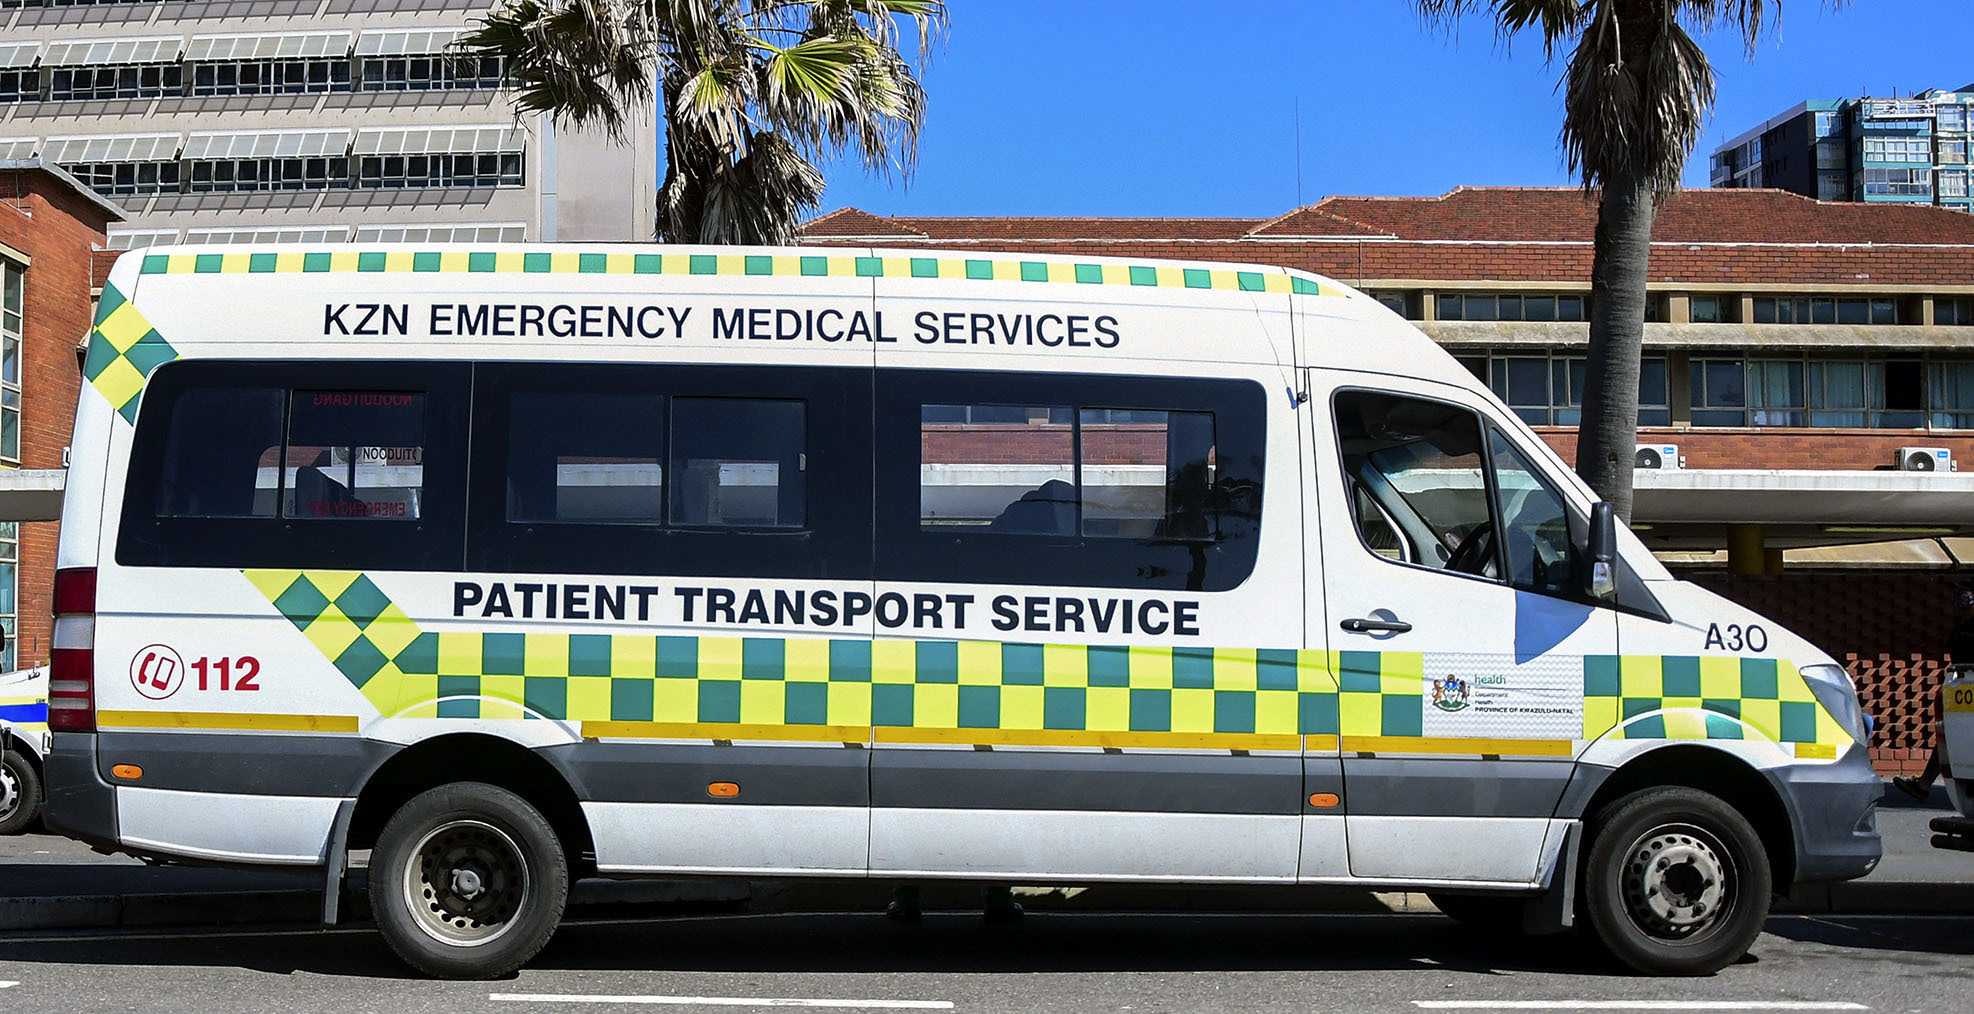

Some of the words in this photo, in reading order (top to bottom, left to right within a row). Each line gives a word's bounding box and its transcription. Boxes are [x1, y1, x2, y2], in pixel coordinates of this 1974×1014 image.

[323, 303, 409, 336] KZN
[429, 304, 692, 339] EMERGENCY
[712, 307, 898, 343] MEDICAL
[914, 311, 1120, 348] SERVICES
[453, 581, 659, 621] PATIENT
[674, 586, 973, 629] TRANSPORT
[991, 594, 1200, 636] SERVICE
[191, 656, 260, 691] 112
[1475, 674, 1506, 684] health
